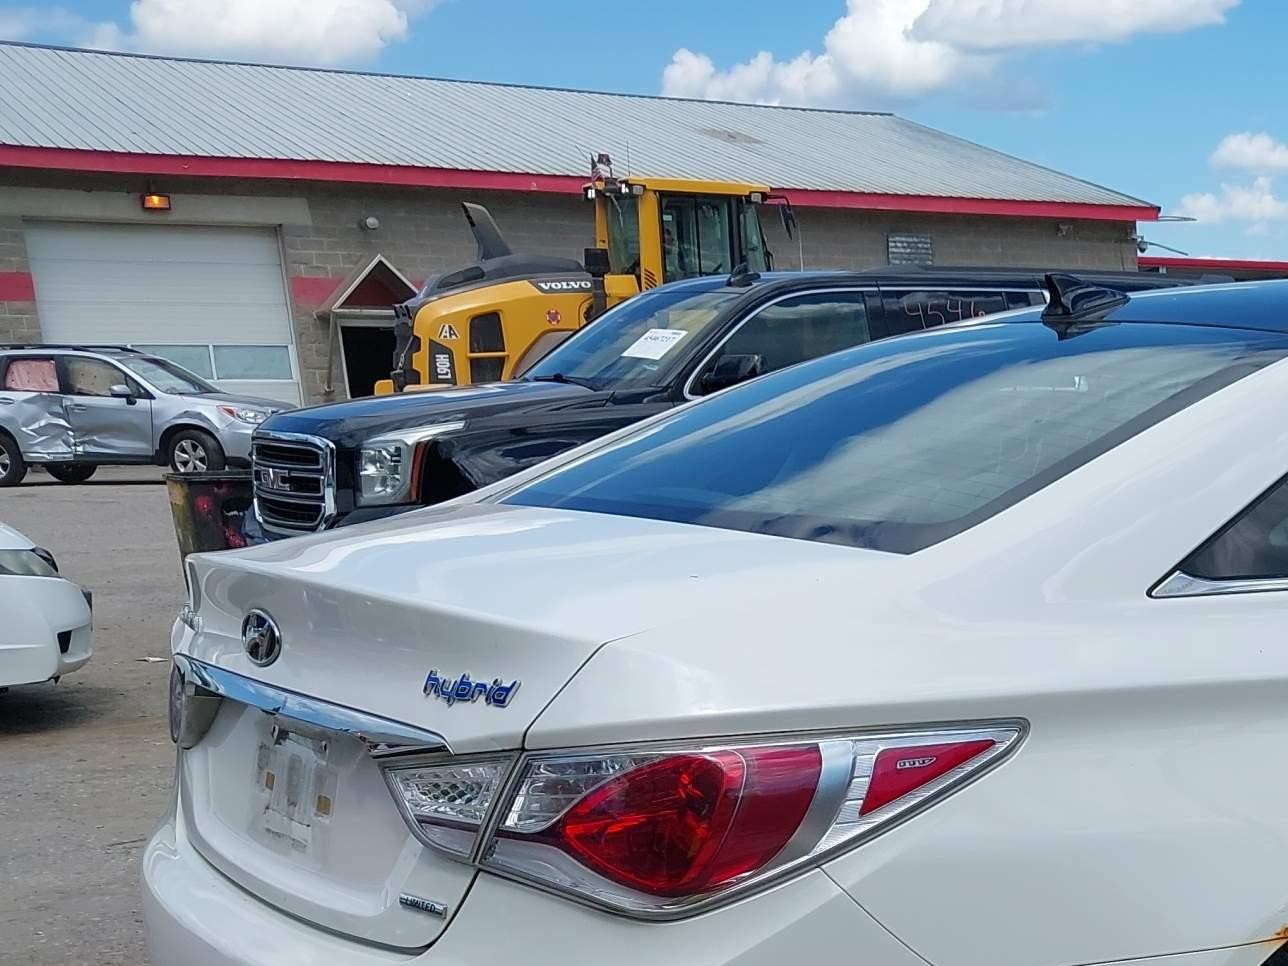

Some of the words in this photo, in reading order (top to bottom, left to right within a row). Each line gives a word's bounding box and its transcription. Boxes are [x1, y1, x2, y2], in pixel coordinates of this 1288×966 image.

[537, 280, 592, 290] VOLVO
[260, 467, 290, 491] GMC
[422, 667, 522, 708] hybrid
